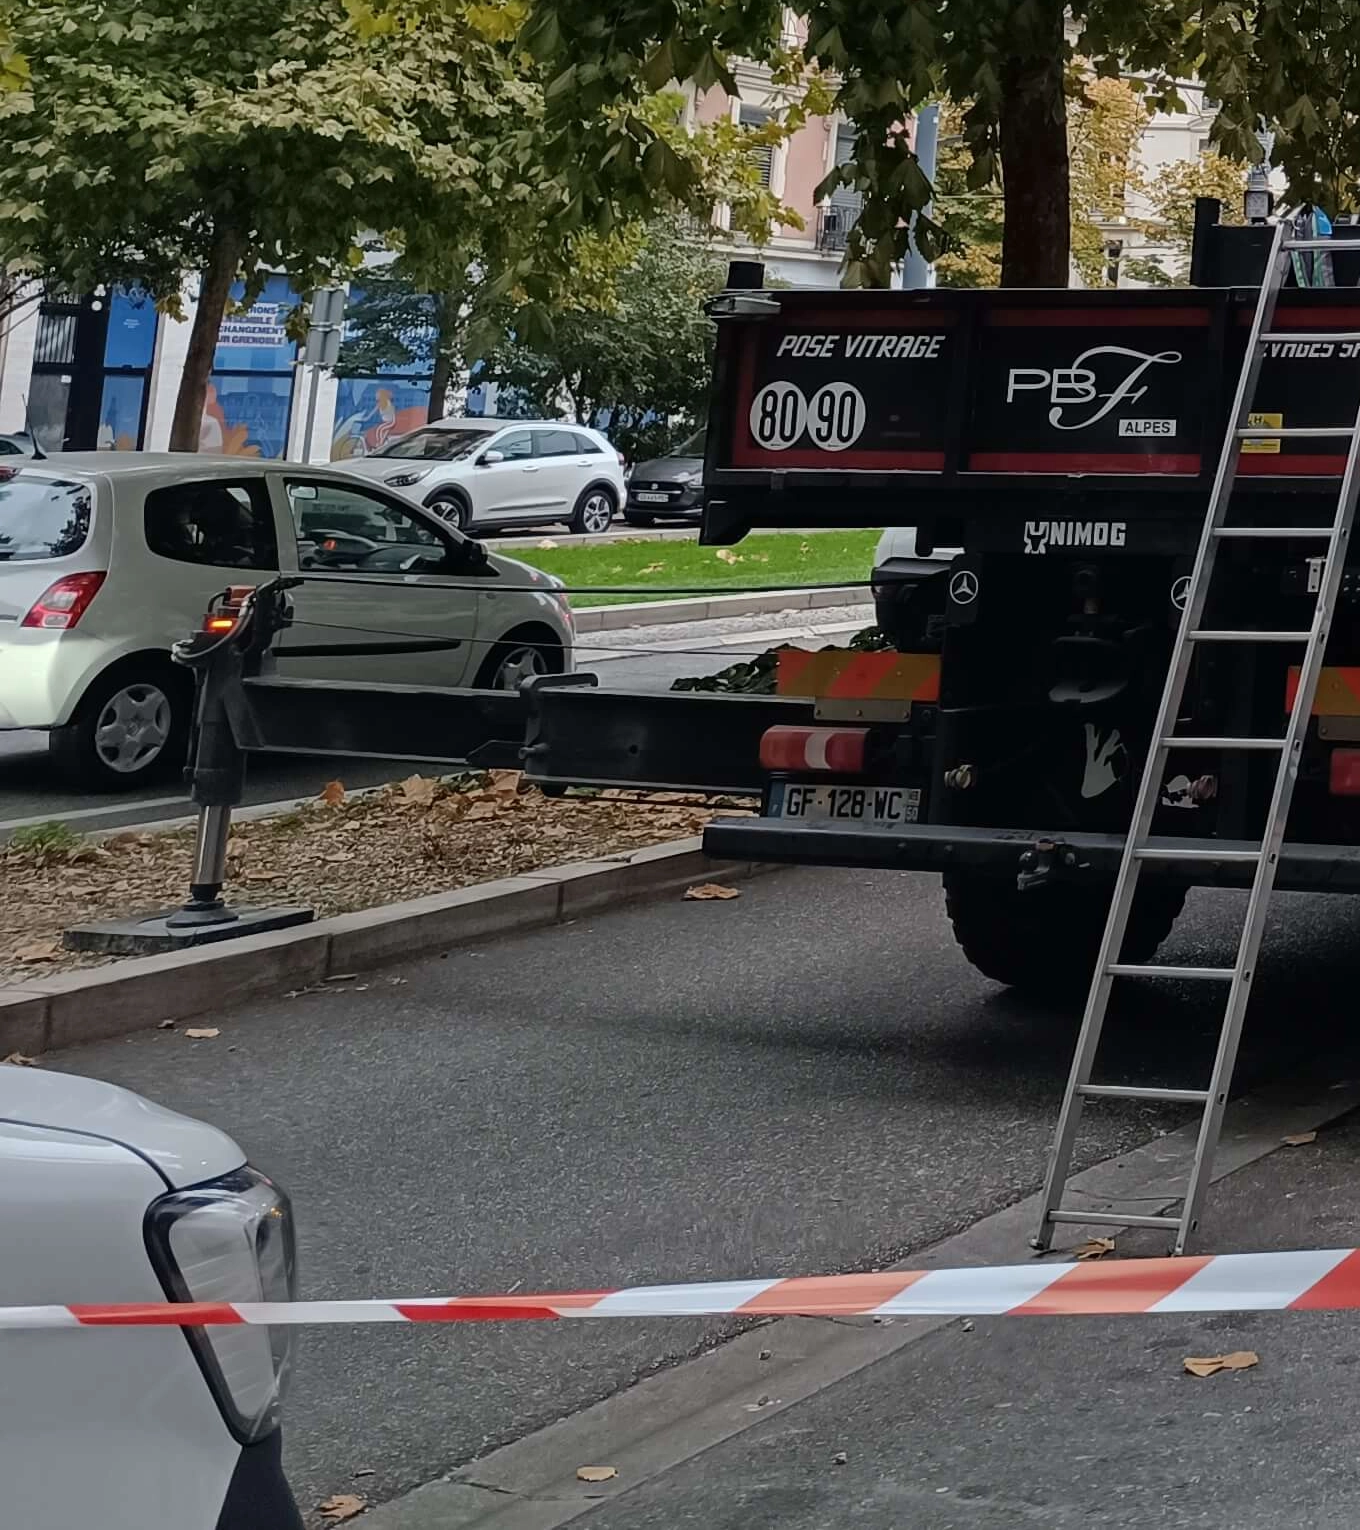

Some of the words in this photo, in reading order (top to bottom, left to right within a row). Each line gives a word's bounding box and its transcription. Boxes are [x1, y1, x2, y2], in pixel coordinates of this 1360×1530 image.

[776, 334, 841, 358] POSE
[844, 335, 946, 359] VITRAGE
[758, 389, 799, 443] 80
[815, 389, 857, 444] 90
[1124, 421, 1171, 434] ALPES
[1023, 521, 1127, 555] UNIMOG
[786, 787, 903, 820] GF-128-WC
